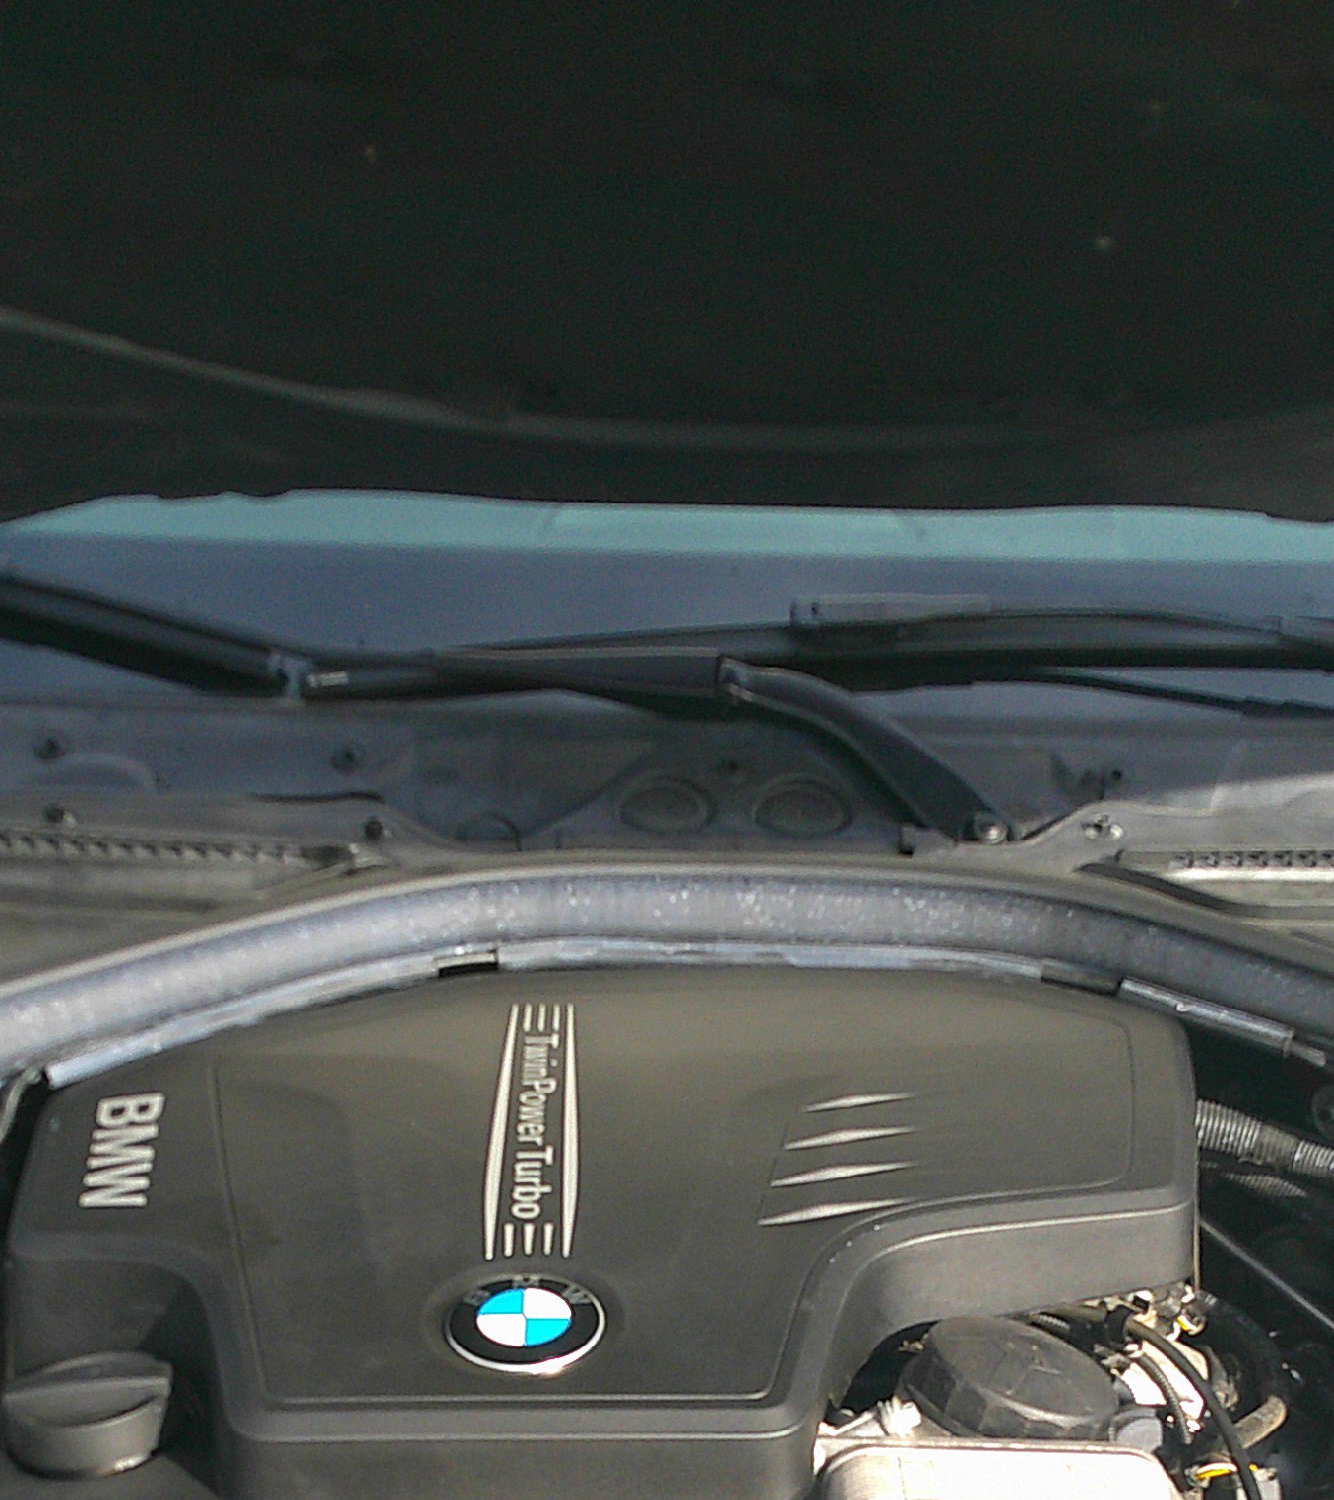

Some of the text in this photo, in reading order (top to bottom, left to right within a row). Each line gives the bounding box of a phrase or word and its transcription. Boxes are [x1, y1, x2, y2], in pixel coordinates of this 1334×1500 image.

[77, 1091, 165, 1209] BMW
[511, 1032, 560, 1220] TwinPower Turbo
